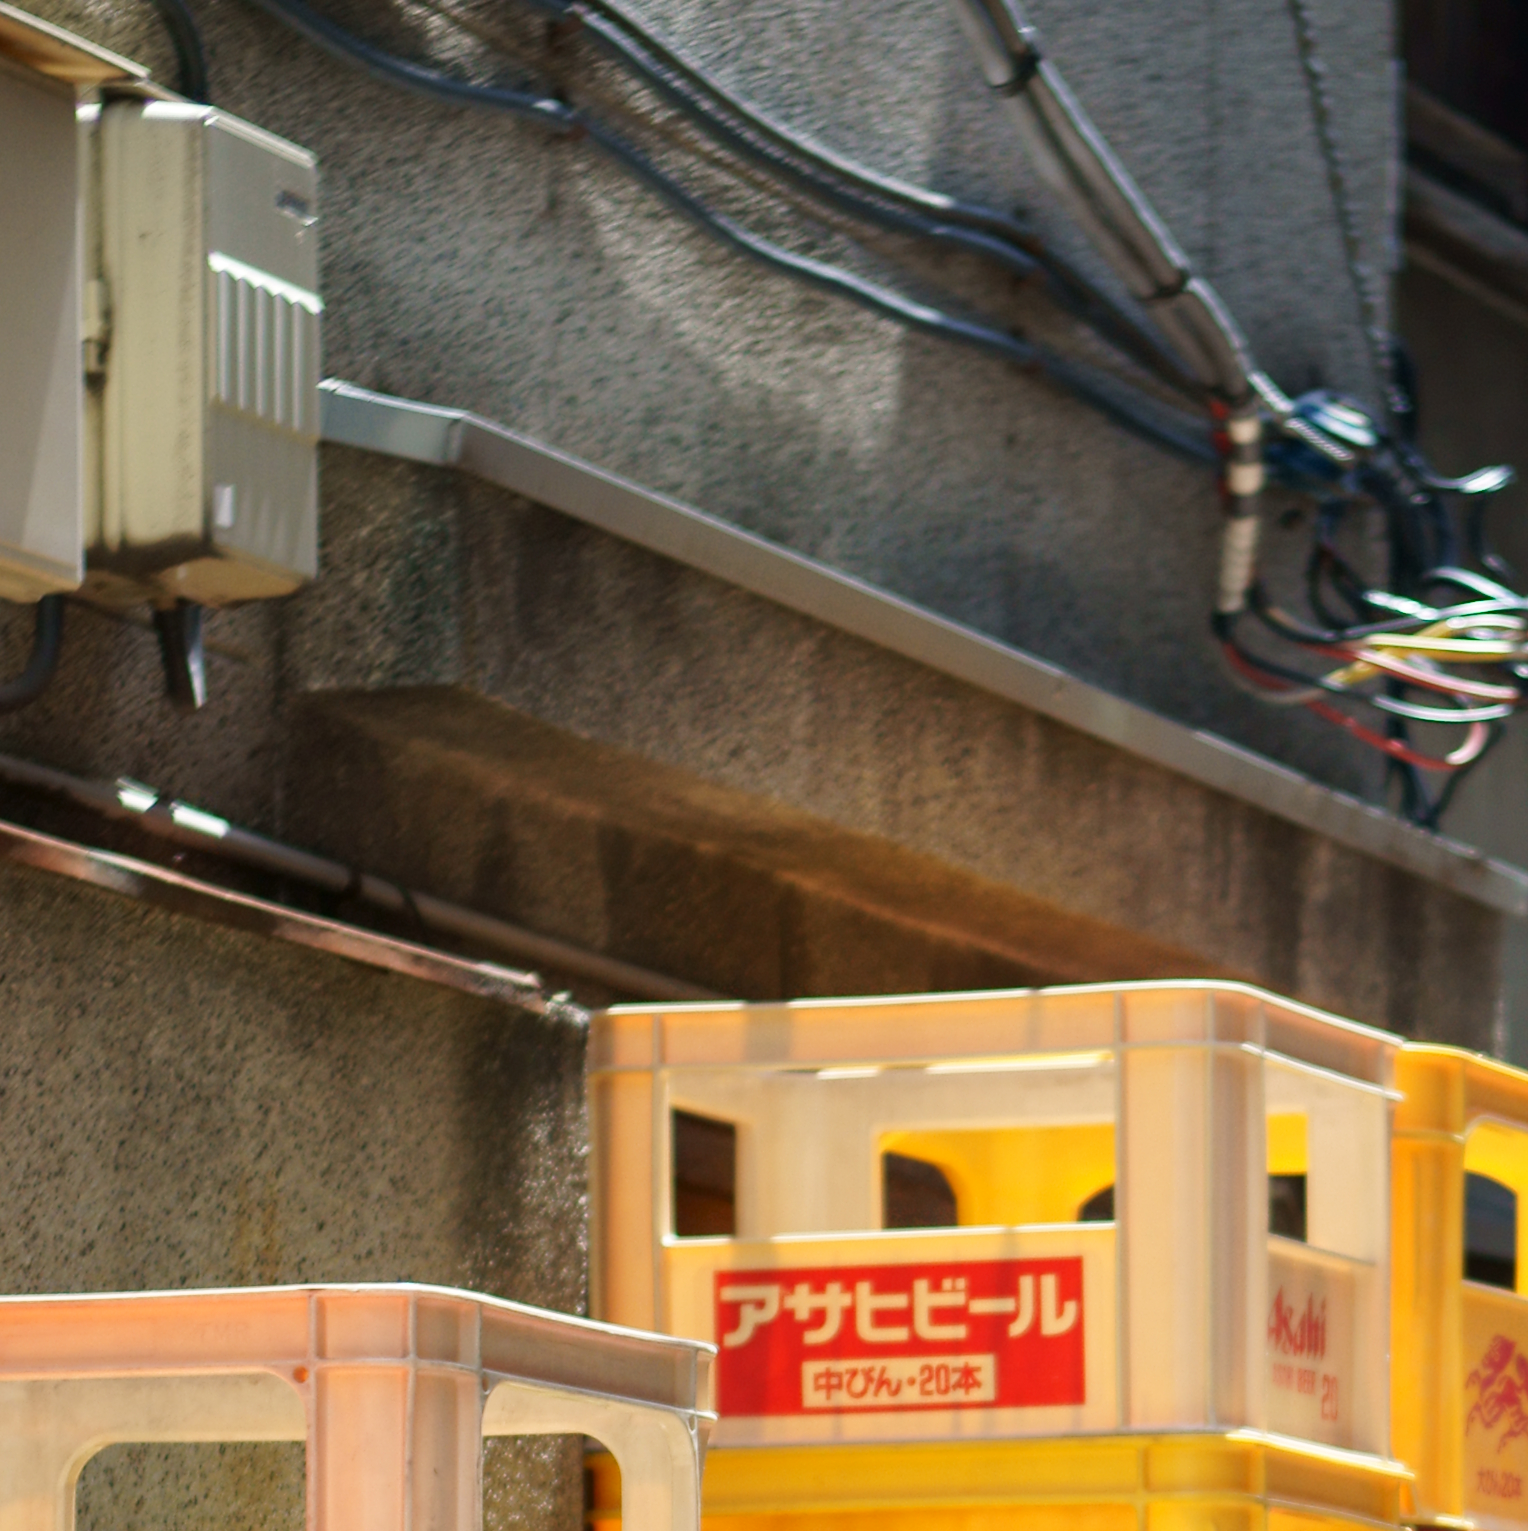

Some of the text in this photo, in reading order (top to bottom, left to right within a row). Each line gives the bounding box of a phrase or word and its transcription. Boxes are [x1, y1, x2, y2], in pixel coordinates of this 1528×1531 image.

[721, 1273, 1076, 1347] アサヒビール
[1268, 1286, 1326, 1360] Asahi
[813, 1360, 982, 1400] 中びん・20本
